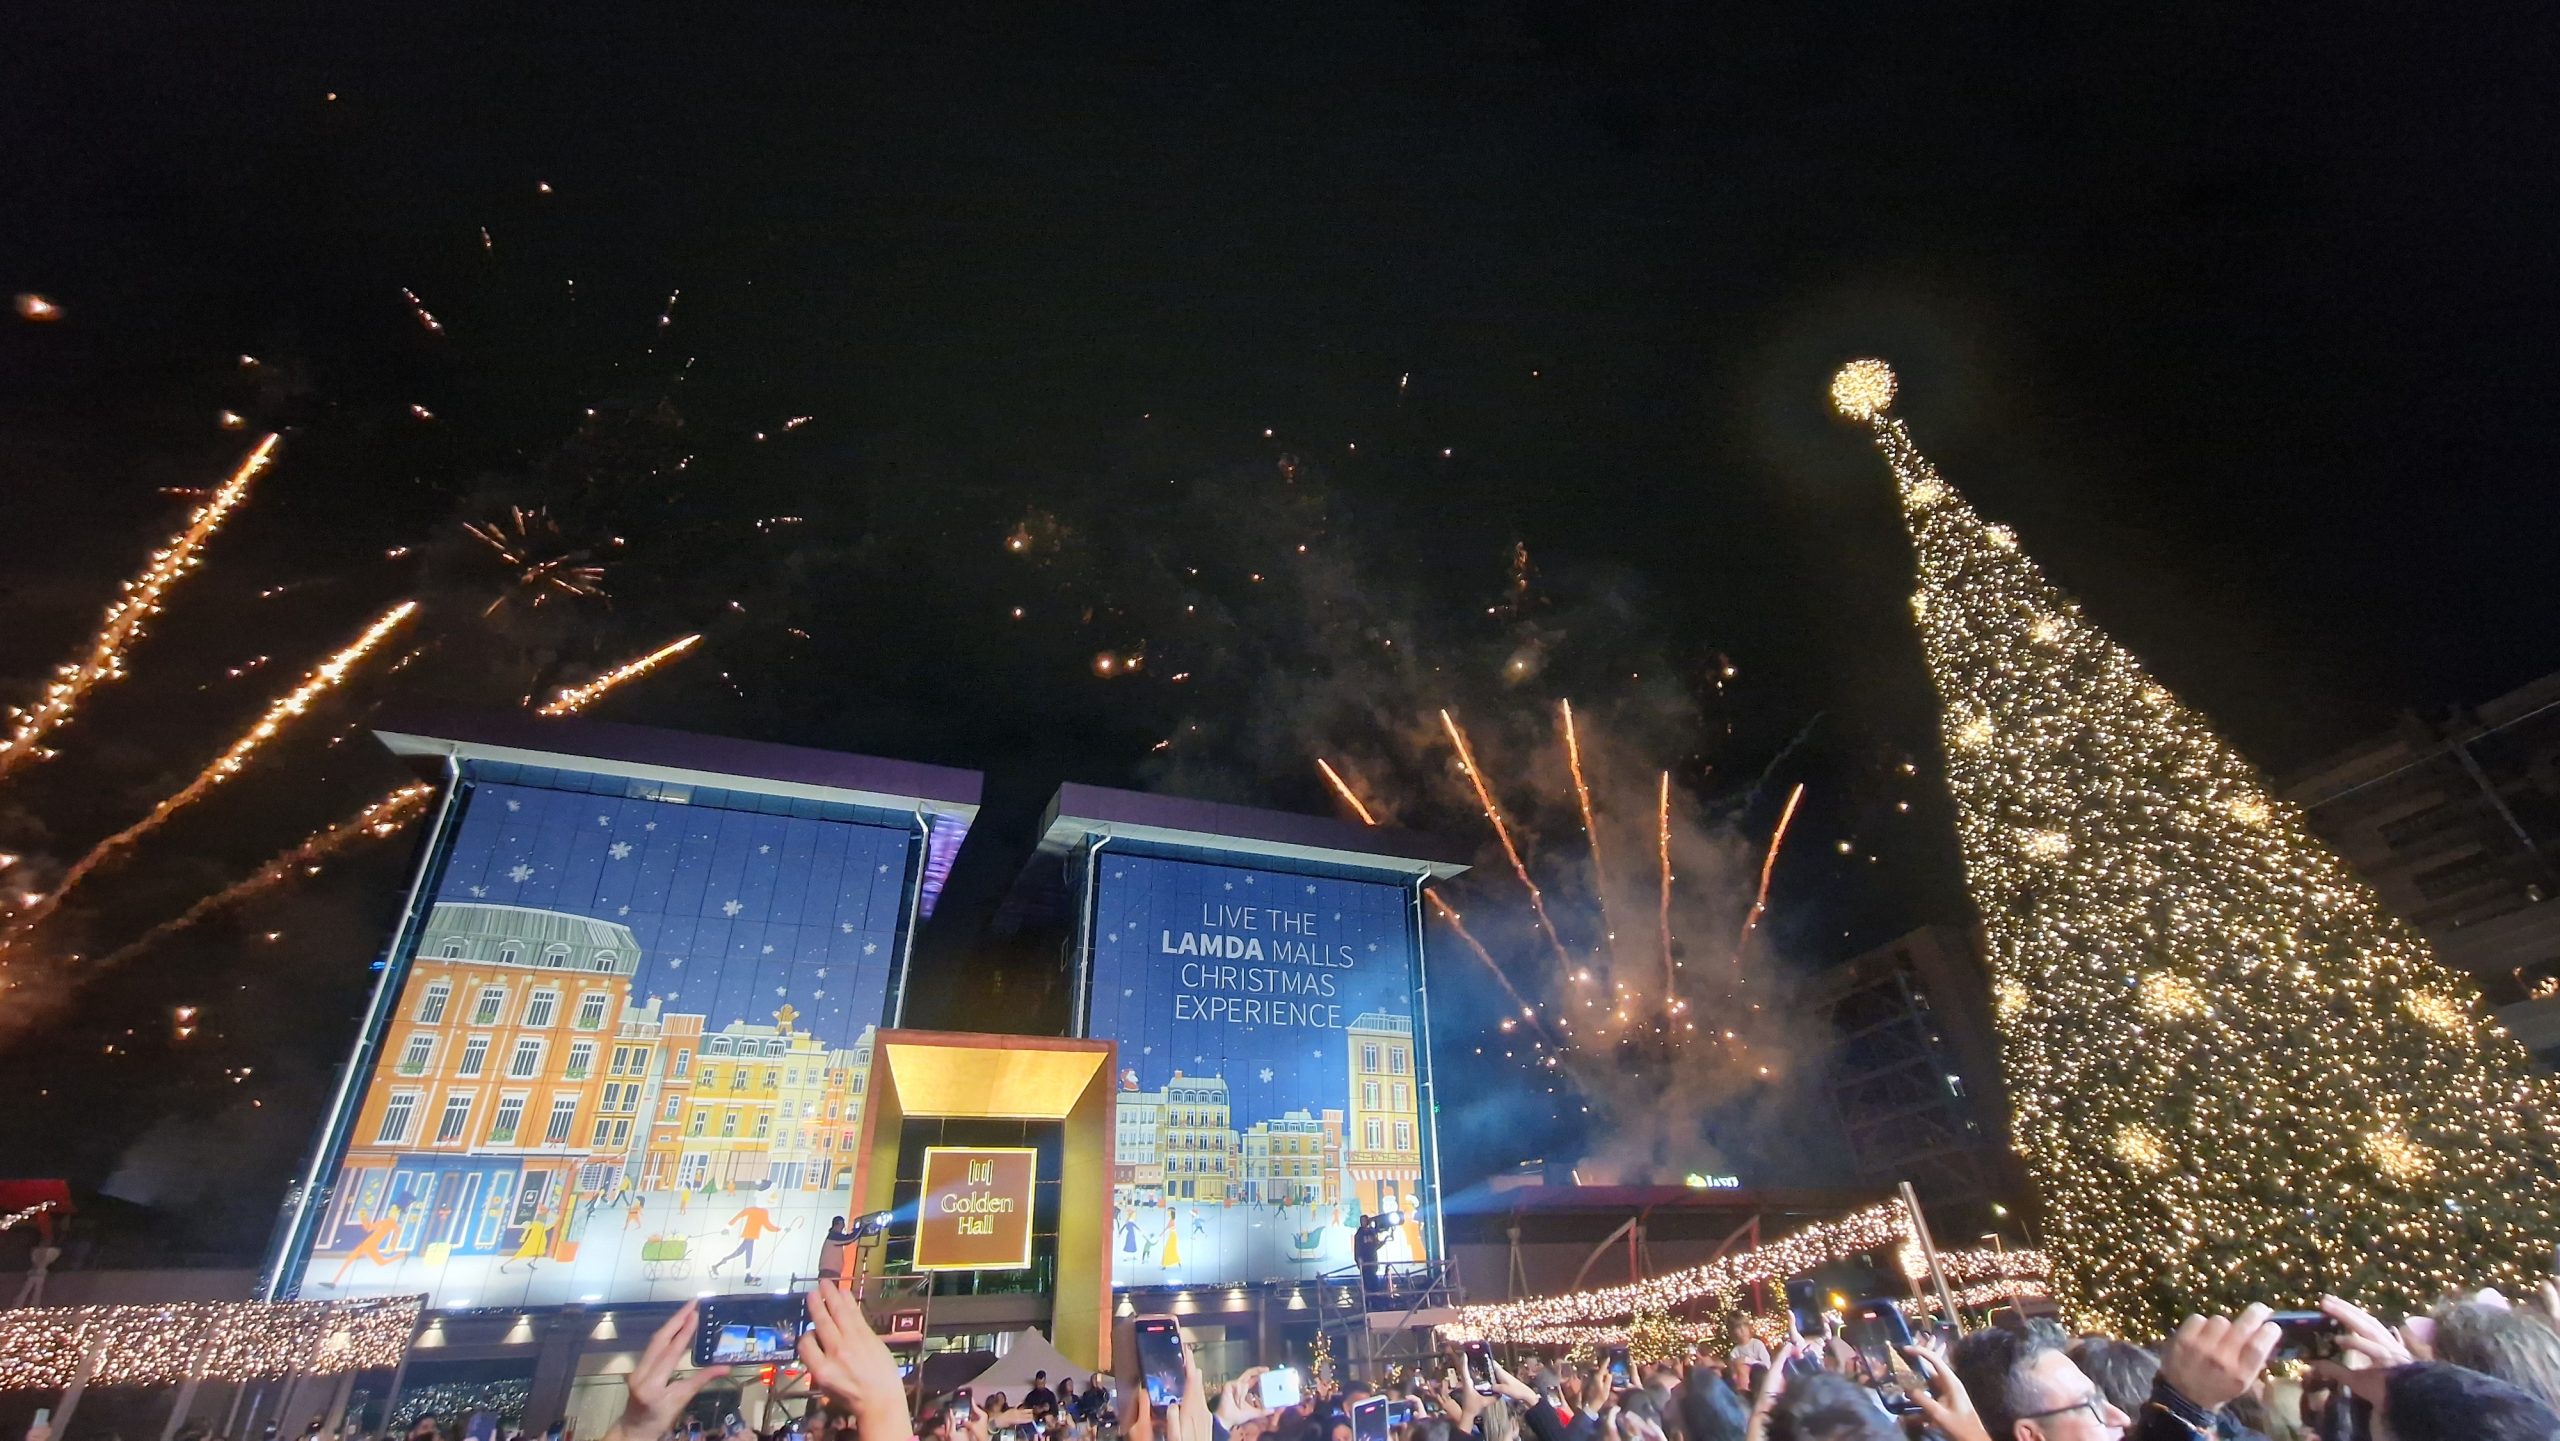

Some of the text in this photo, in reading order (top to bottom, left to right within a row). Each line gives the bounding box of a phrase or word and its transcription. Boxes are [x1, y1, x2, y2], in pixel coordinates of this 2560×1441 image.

[1203, 902, 1318, 936] LIVE THE
[1161, 930, 1355, 969] LAMDA MALLS
[1181, 963, 1336, 997] CHRISTMAS
[1175, 994, 1342, 1029] EXPERIENCE
[941, 1191, 1014, 1213] Golden
[958, 1215, 994, 1235] Hall
